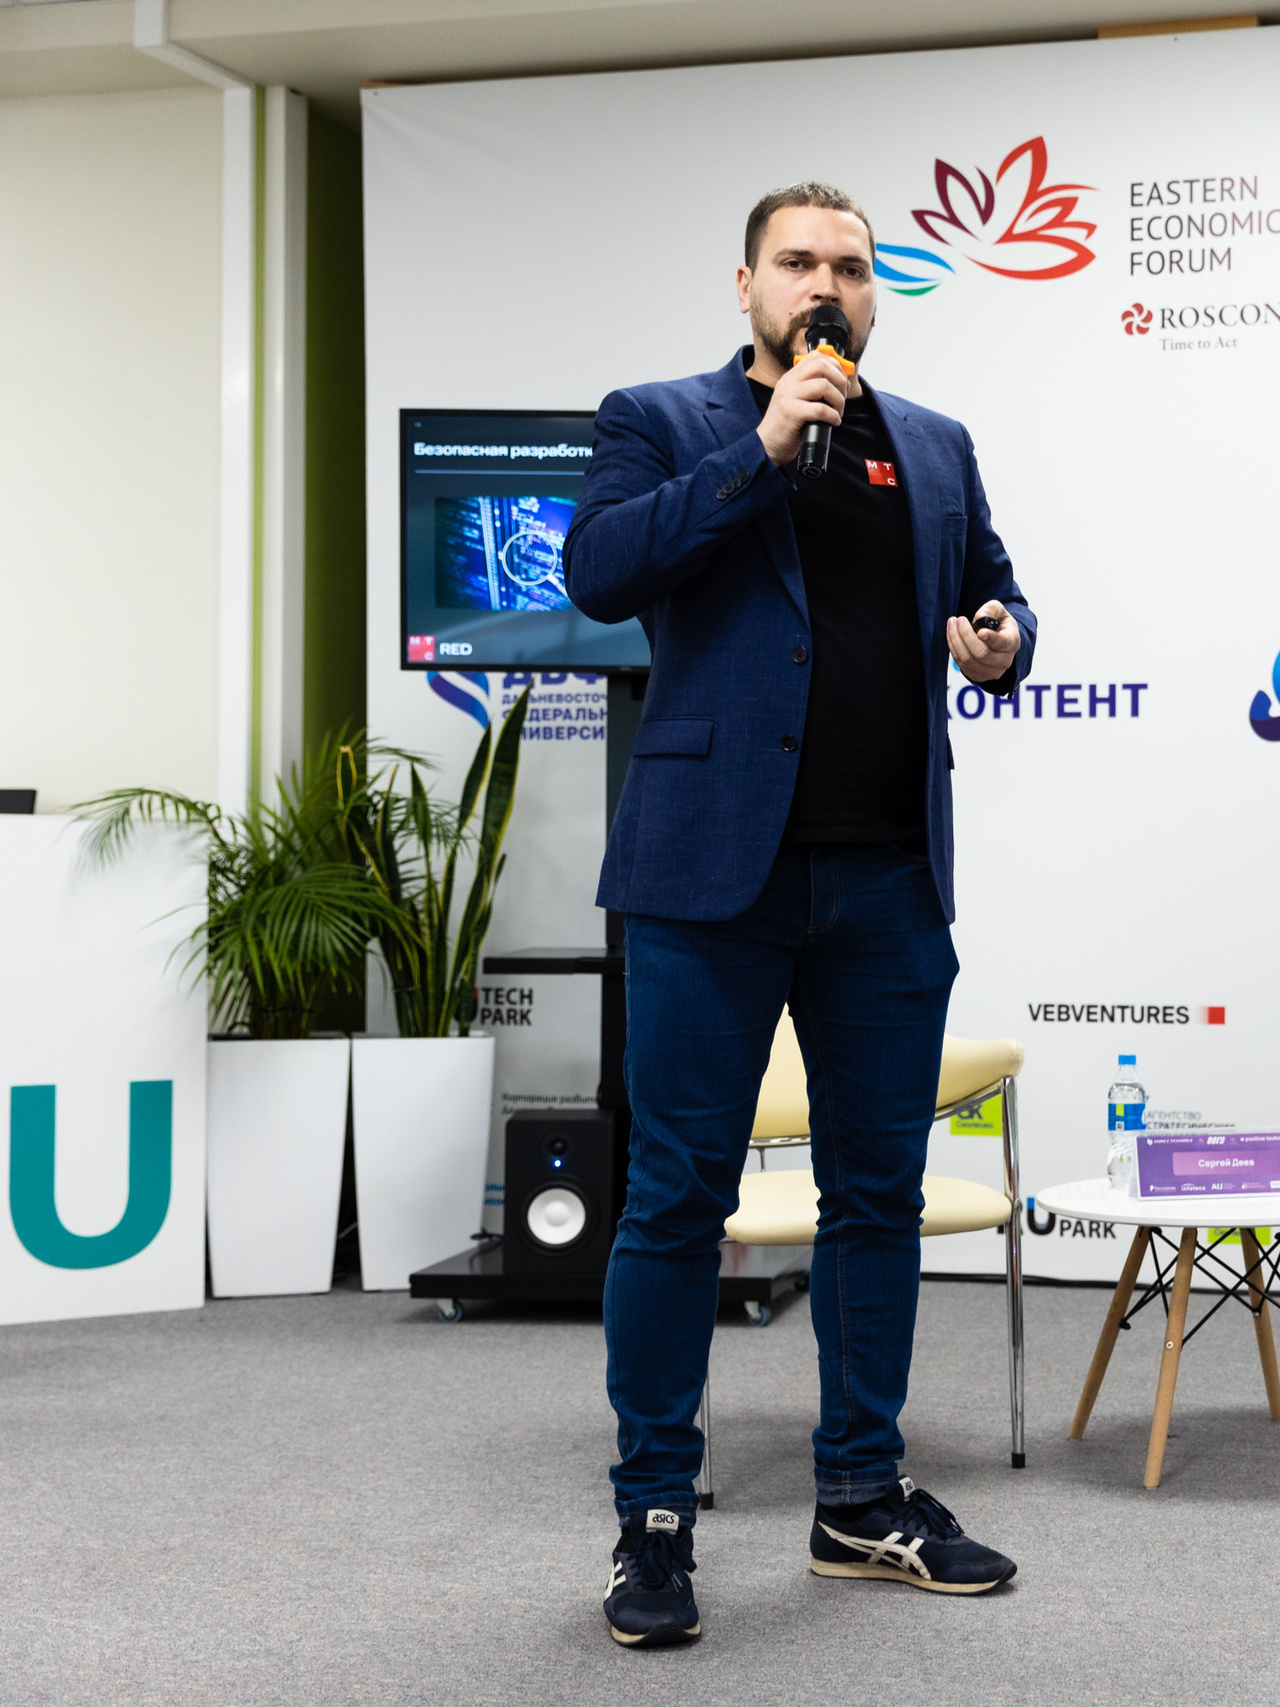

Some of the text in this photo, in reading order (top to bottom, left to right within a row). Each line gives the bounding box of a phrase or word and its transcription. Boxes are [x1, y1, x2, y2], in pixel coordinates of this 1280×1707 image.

[1130, 176, 1258, 207] EASTERN
[1130, 247, 1232, 276] FORUM
[1159, 337, 1237, 351] Time to Act
[414, 442, 508, 456] Безопасная
[439, 643, 473, 656] RED
[481, 987, 533, 1006] TECH
[480, 1007, 532, 1026] PARK
[1028, 1003, 1190, 1024] VEBVENTURES
[1198, 1158, 1255, 1169] Сергей Деев
[1059, 1220, 1117, 1239] PARK
[652, 1513, 675, 1524] asics
